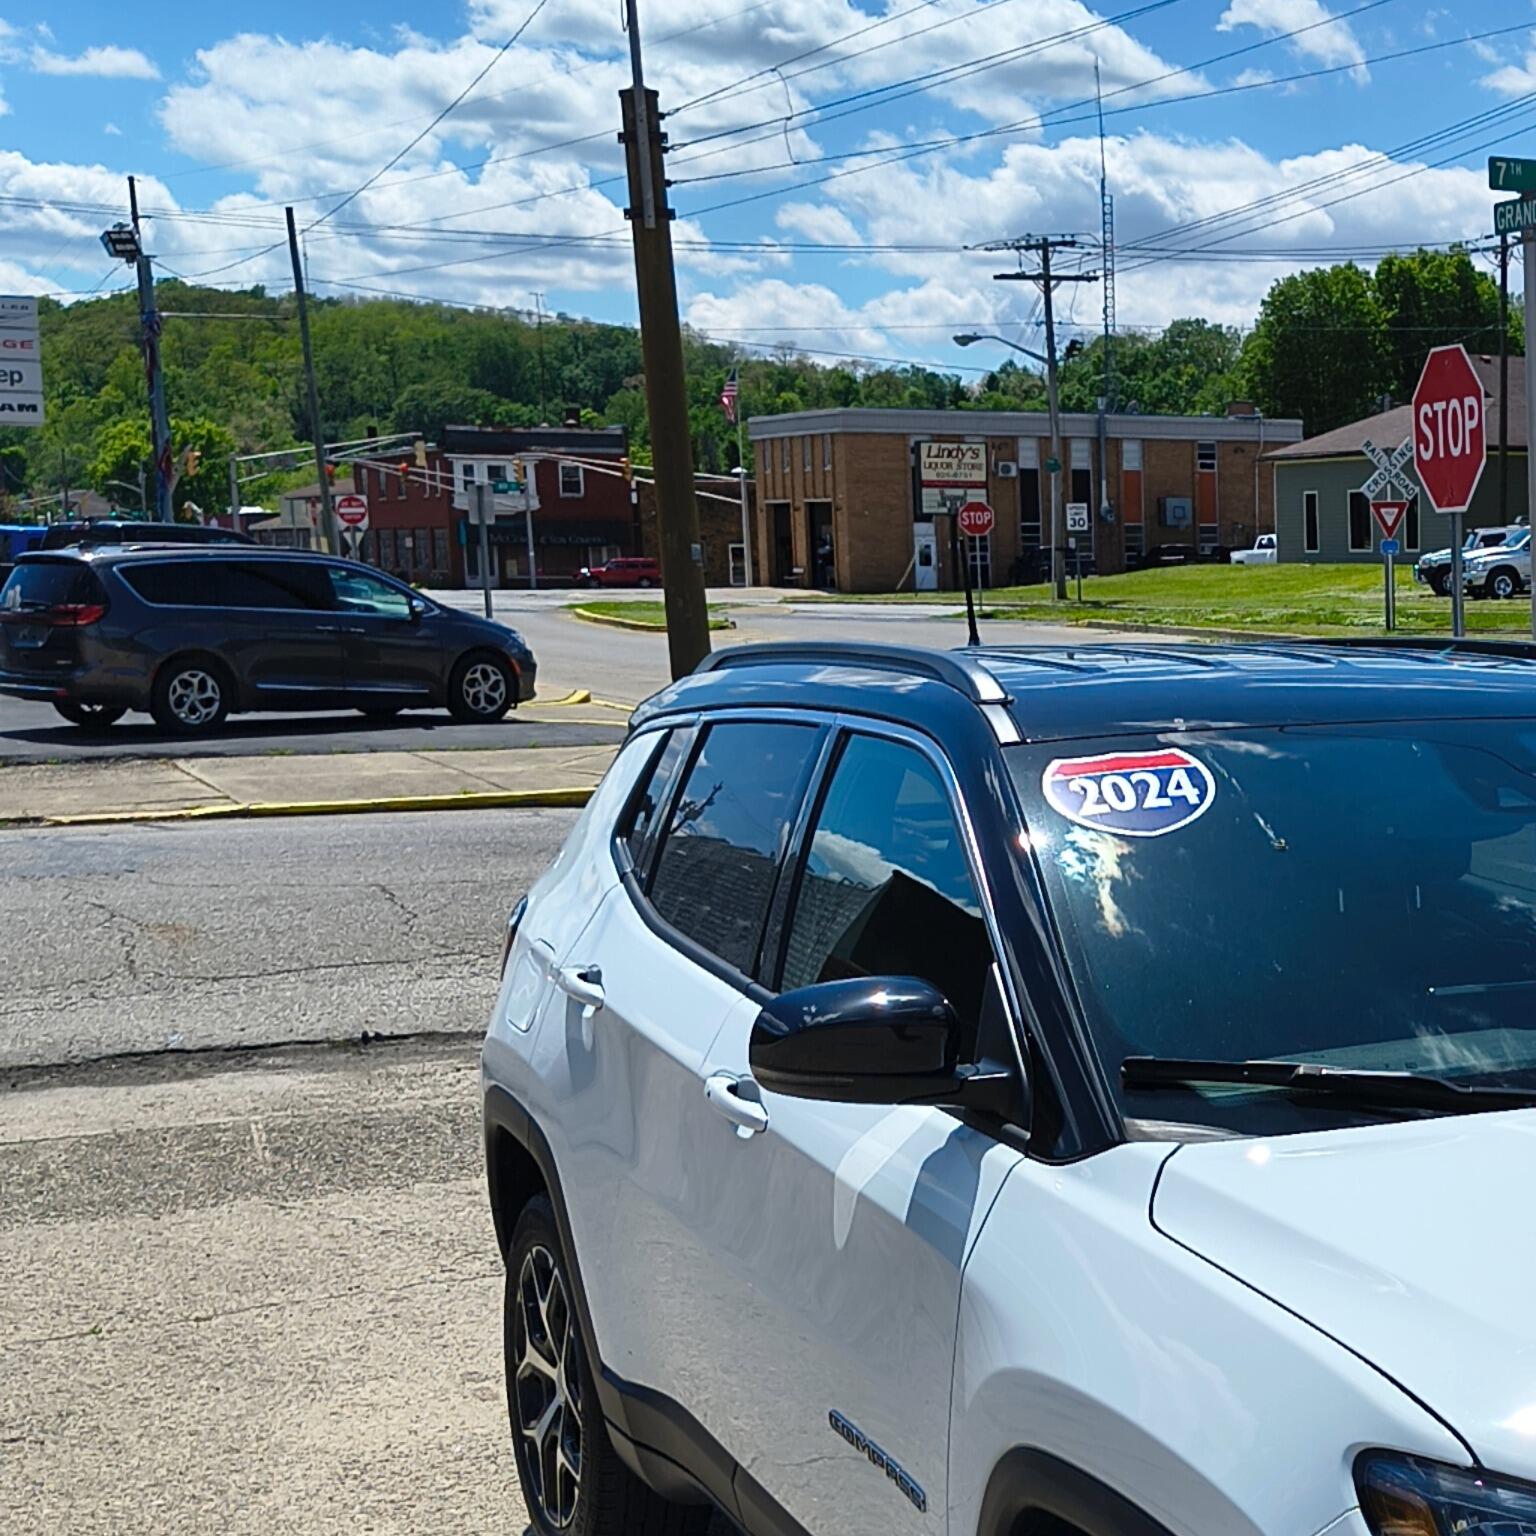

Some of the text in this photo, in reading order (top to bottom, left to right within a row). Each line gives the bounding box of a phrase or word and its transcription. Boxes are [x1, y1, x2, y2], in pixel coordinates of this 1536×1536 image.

[1495, 161, 1522, 186] 7TH
[1419, 396, 1480, 461] STOP
[926, 445, 980, 461] Lindy's
[923, 461, 985, 472] LIQUOR STORE
[1362, 440, 1416, 499] RAIL ROAD
[1366, 441, 1414, 495] CROSSING
[961, 511, 992, 526] STOP
[1069, 517, 1086, 528] 30
[1067, 768, 1201, 817] 2024
